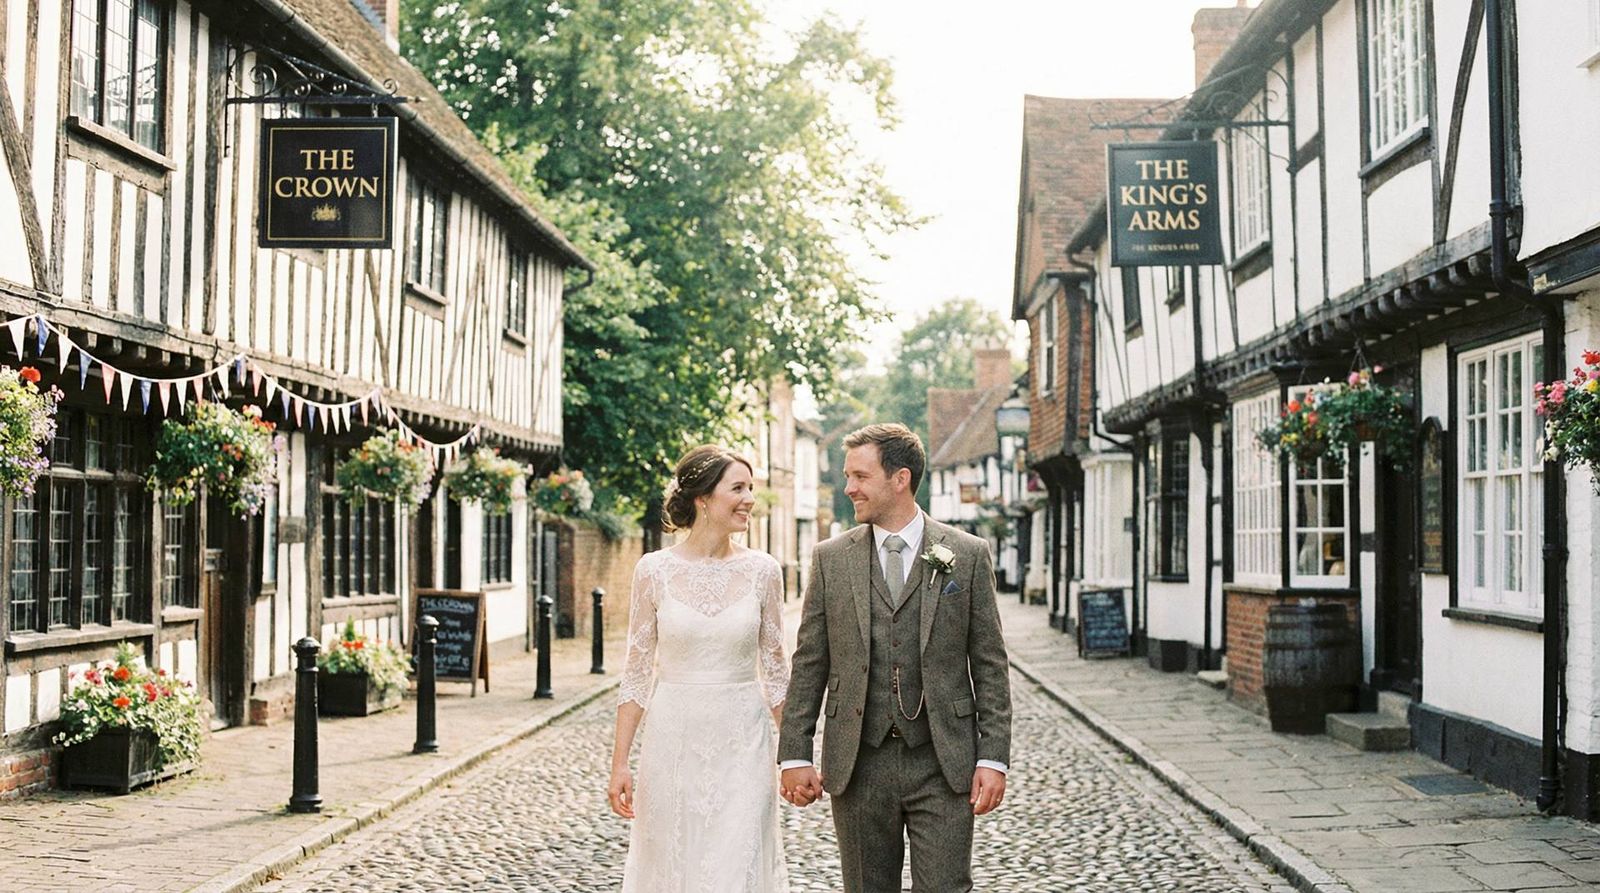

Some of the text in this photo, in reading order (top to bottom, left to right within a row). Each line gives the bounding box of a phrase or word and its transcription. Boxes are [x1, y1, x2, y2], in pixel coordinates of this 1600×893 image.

[300, 149, 355, 170] THE
[1135, 159, 1189, 180] THE
[274, 176, 379, 198] CROWN
[1120, 182, 1208, 206] KING'S
[1127, 209, 1201, 231] ARMS
